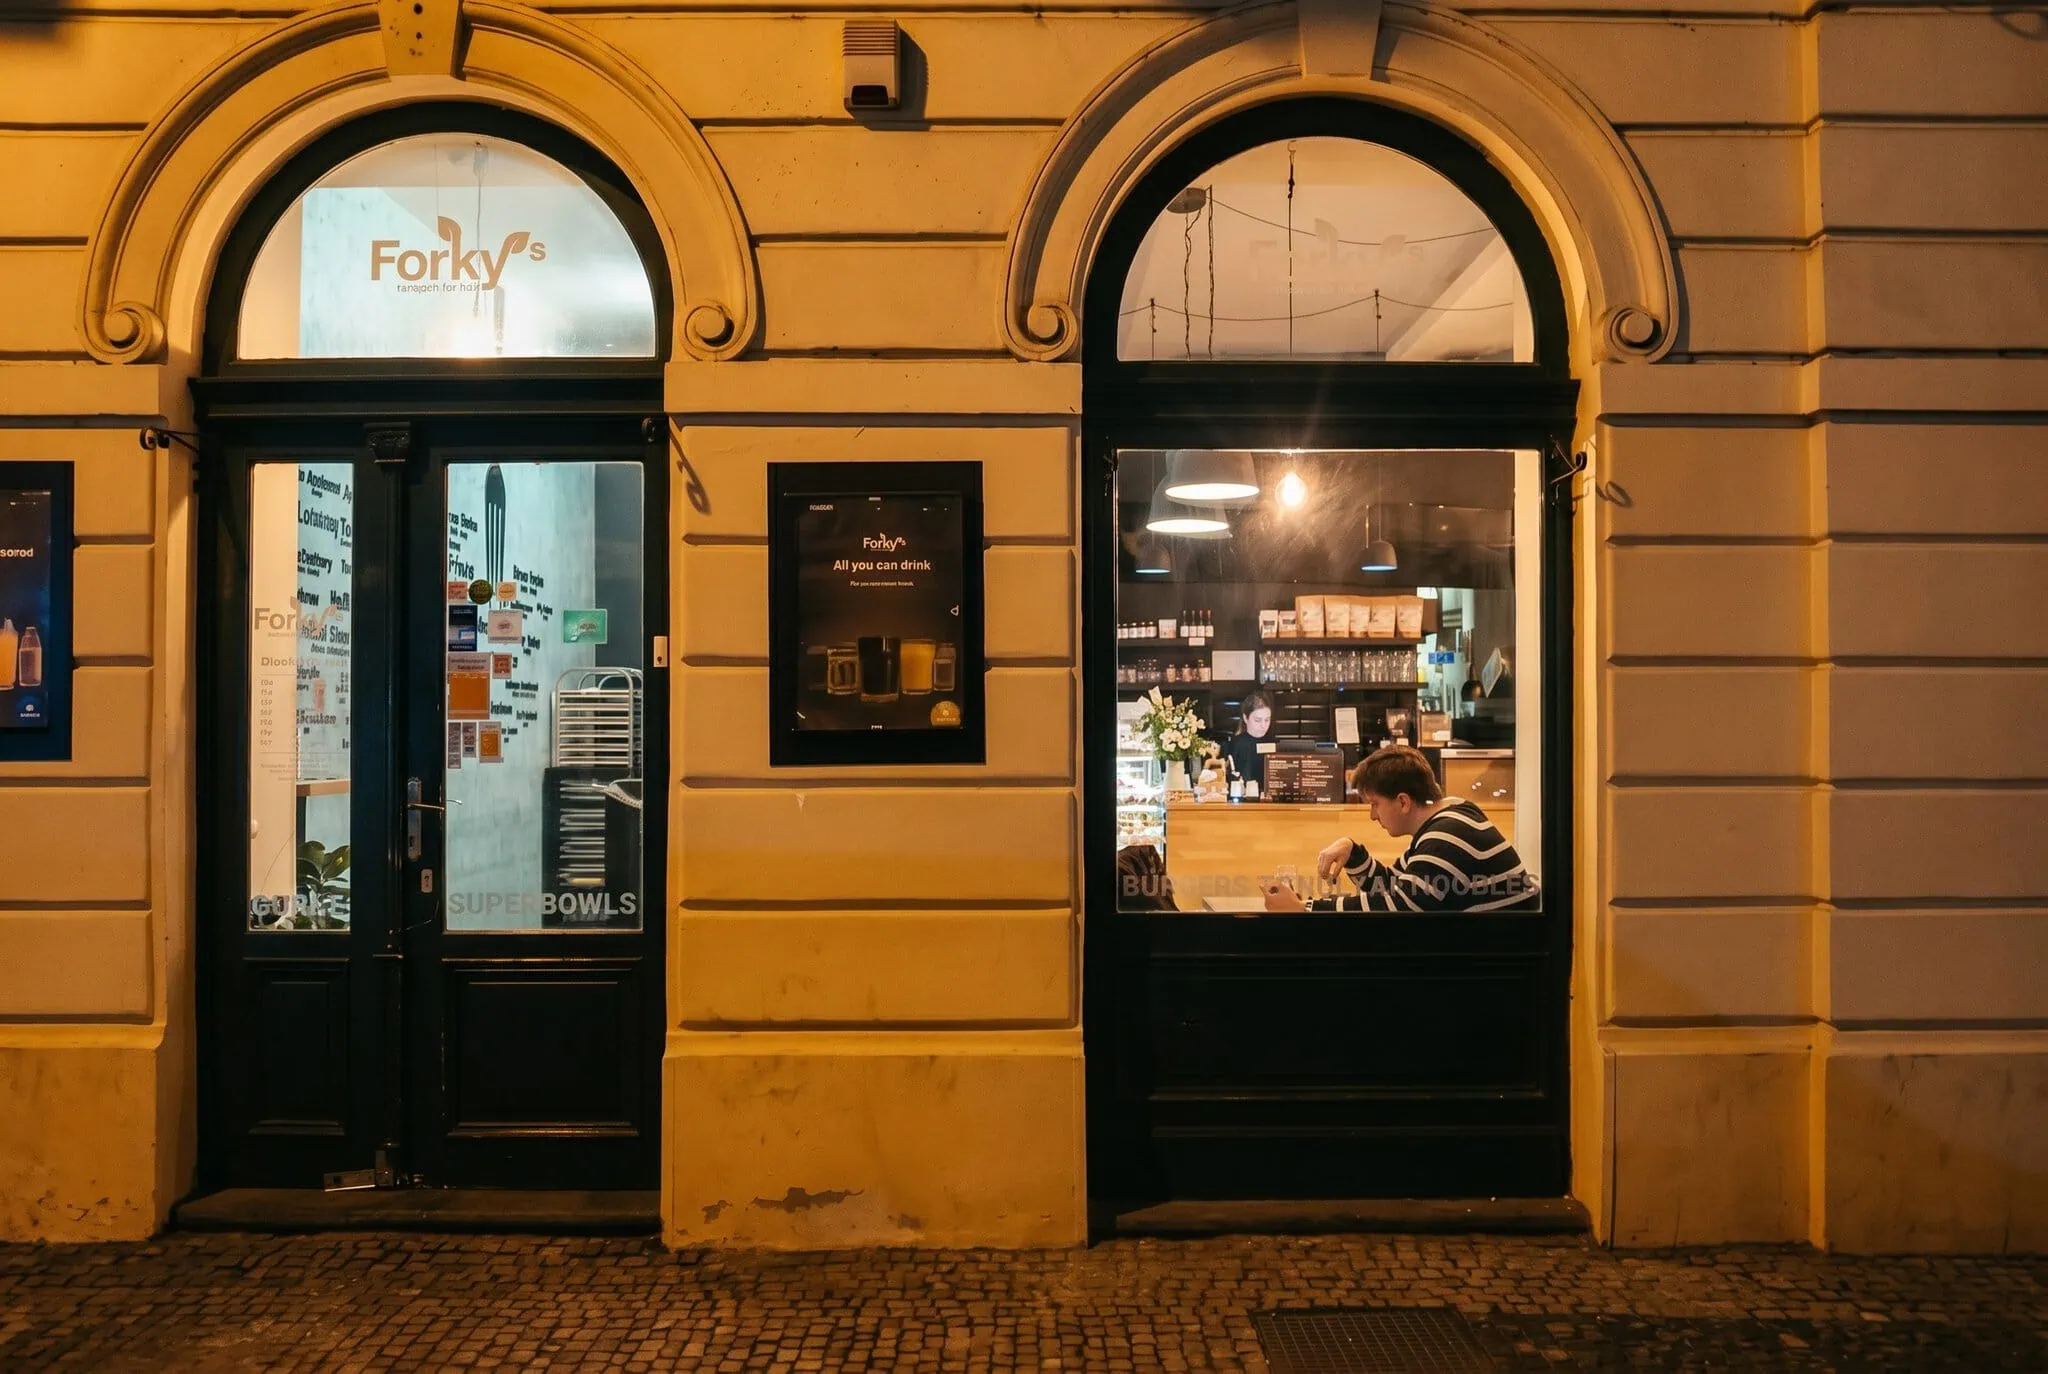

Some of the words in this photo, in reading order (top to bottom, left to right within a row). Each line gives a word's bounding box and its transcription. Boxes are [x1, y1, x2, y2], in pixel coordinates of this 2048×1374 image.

[833, 559, 849, 571] All
[851, 561, 873, 573] you
[876, 561, 898, 571] can
[900, 559, 931, 571] drink
